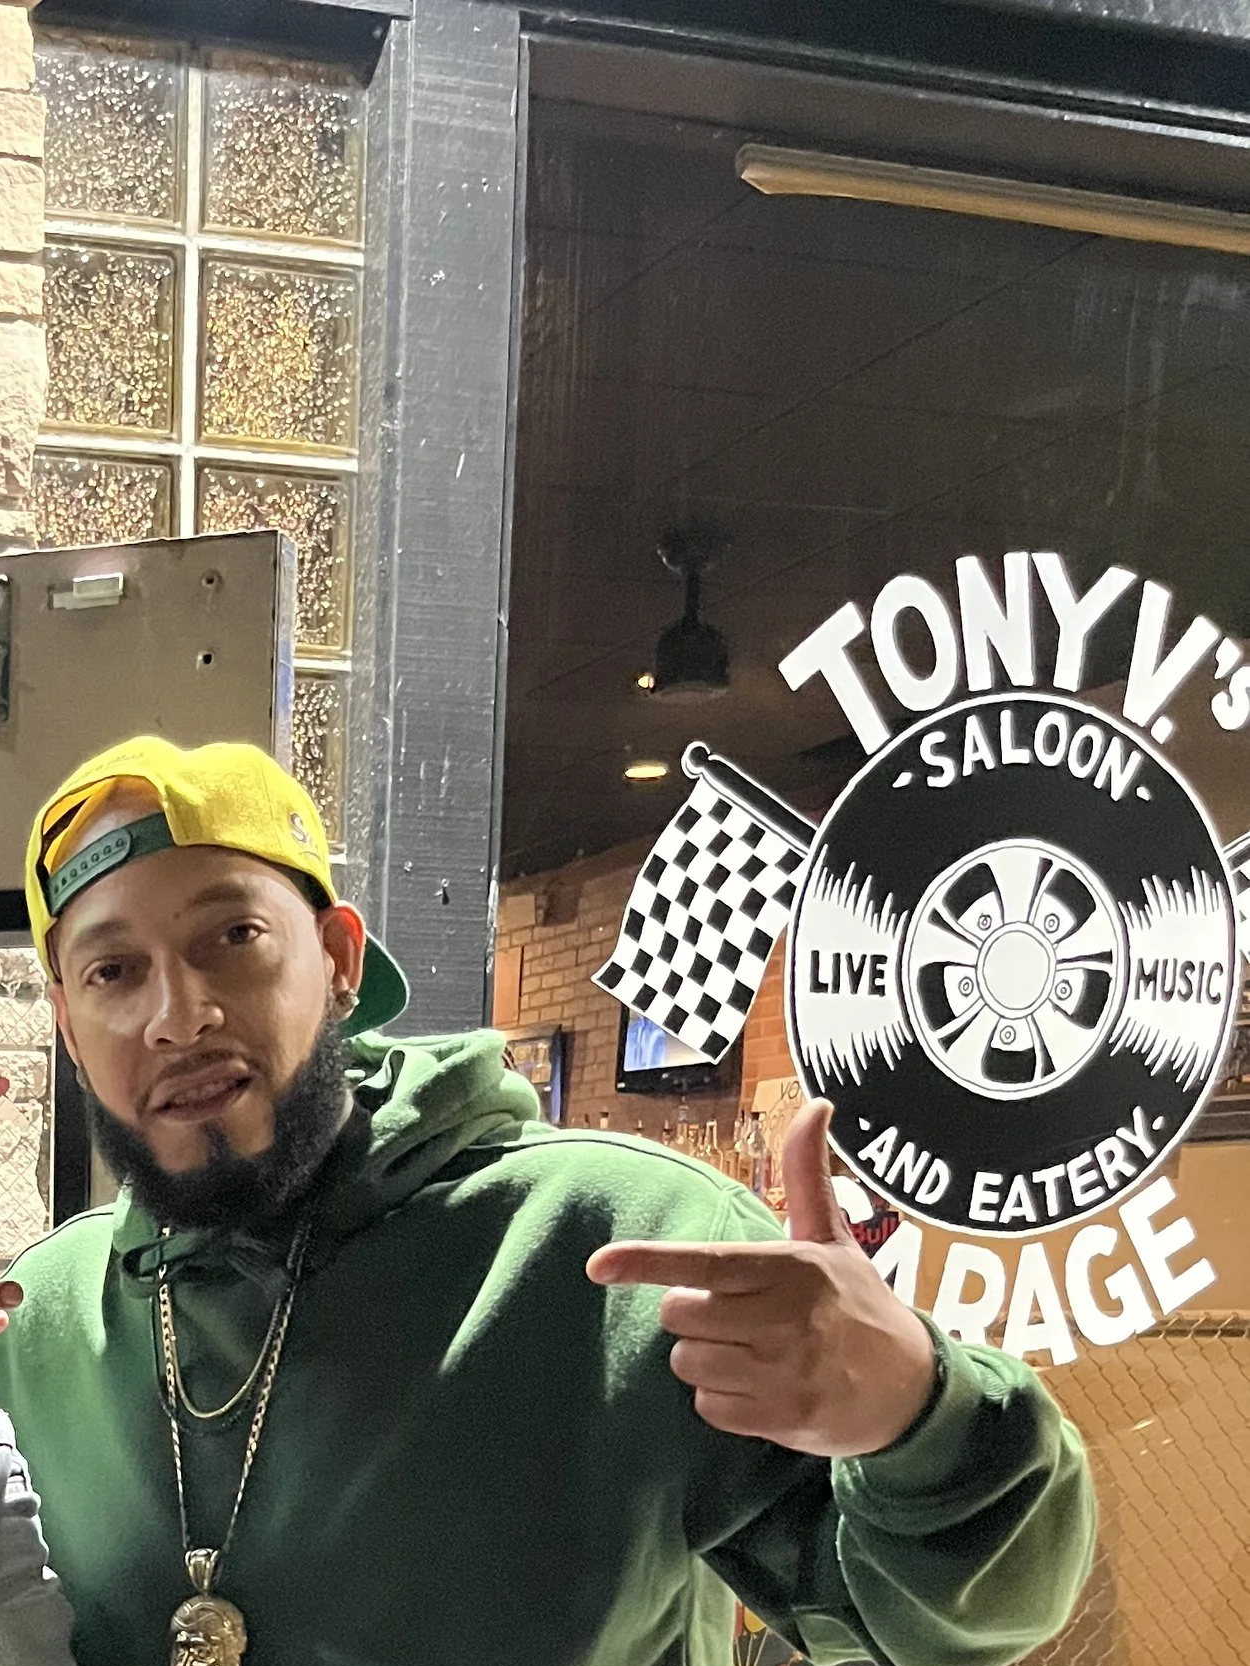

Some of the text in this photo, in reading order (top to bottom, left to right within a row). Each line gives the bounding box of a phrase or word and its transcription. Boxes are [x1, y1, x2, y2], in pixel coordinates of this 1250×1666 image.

[920, 709, 1142, 802] SALOON
[810, 950, 888, 997] LIVE
[1134, 957, 1225, 1005] MUSIC
[857, 1106, 1155, 1224] AND EATERY
